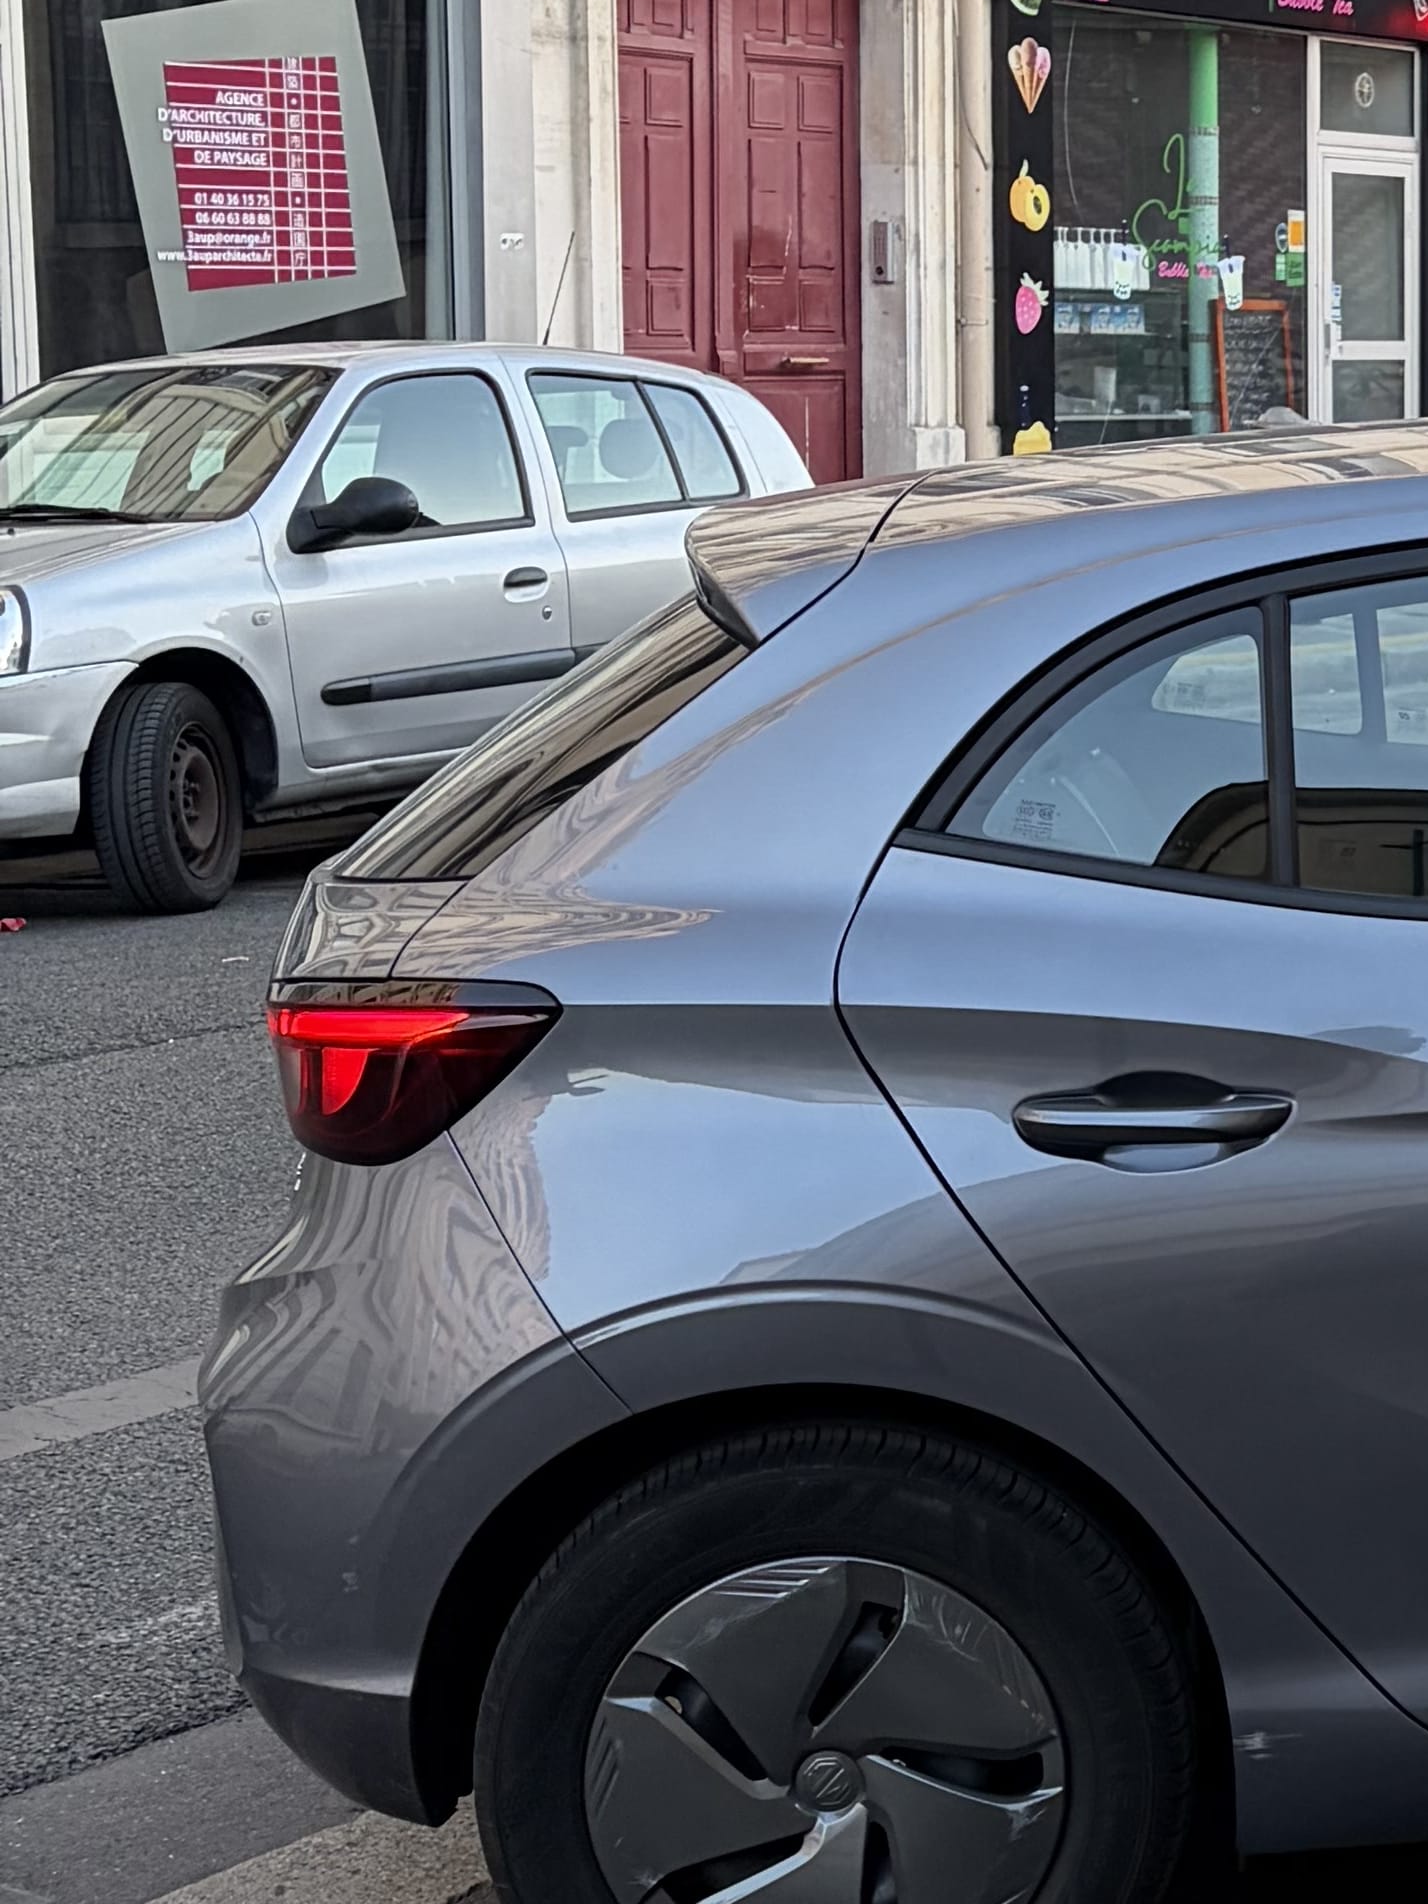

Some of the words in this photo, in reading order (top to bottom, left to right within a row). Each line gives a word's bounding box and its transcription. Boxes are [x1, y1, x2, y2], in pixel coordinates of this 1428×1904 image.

[215, 90, 265, 107] AGENCE
[163, 128, 250, 146] D'URBANISME
[252, 132, 267, 146] ET
[194, 150, 211, 164] DE
[213, 152, 268, 166] PAYSAGE
[194, 192, 207, 204] 01
[210, 192, 224, 205] 40
